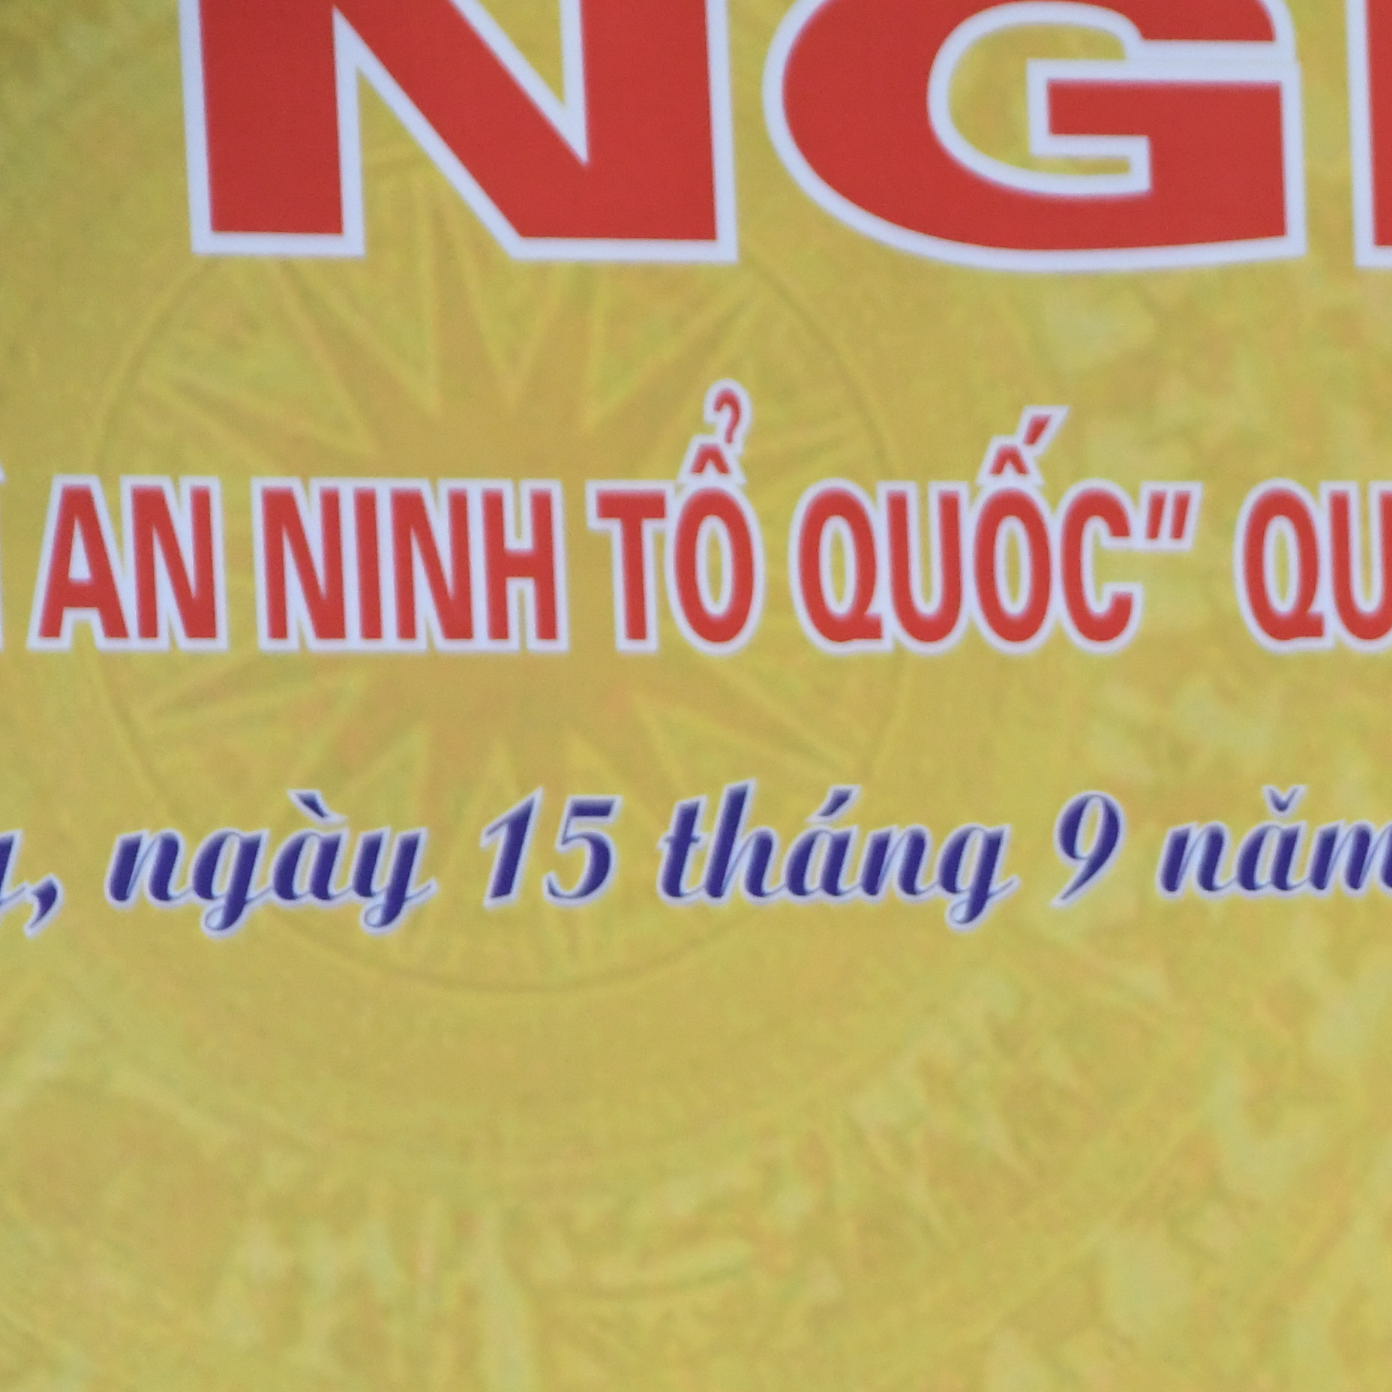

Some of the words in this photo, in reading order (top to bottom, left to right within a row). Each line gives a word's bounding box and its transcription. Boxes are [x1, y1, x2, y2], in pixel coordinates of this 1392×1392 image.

[31, 477, 226, 650] AN
[254, 479, 566, 650] NINH
[588, 382, 763, 653] TỔ
[107, 790, 434, 935] ngày
[483, 790, 619, 905] 15
[659, 782, 1016, 928] tháng
[1053, 791, 1124, 905] 9
